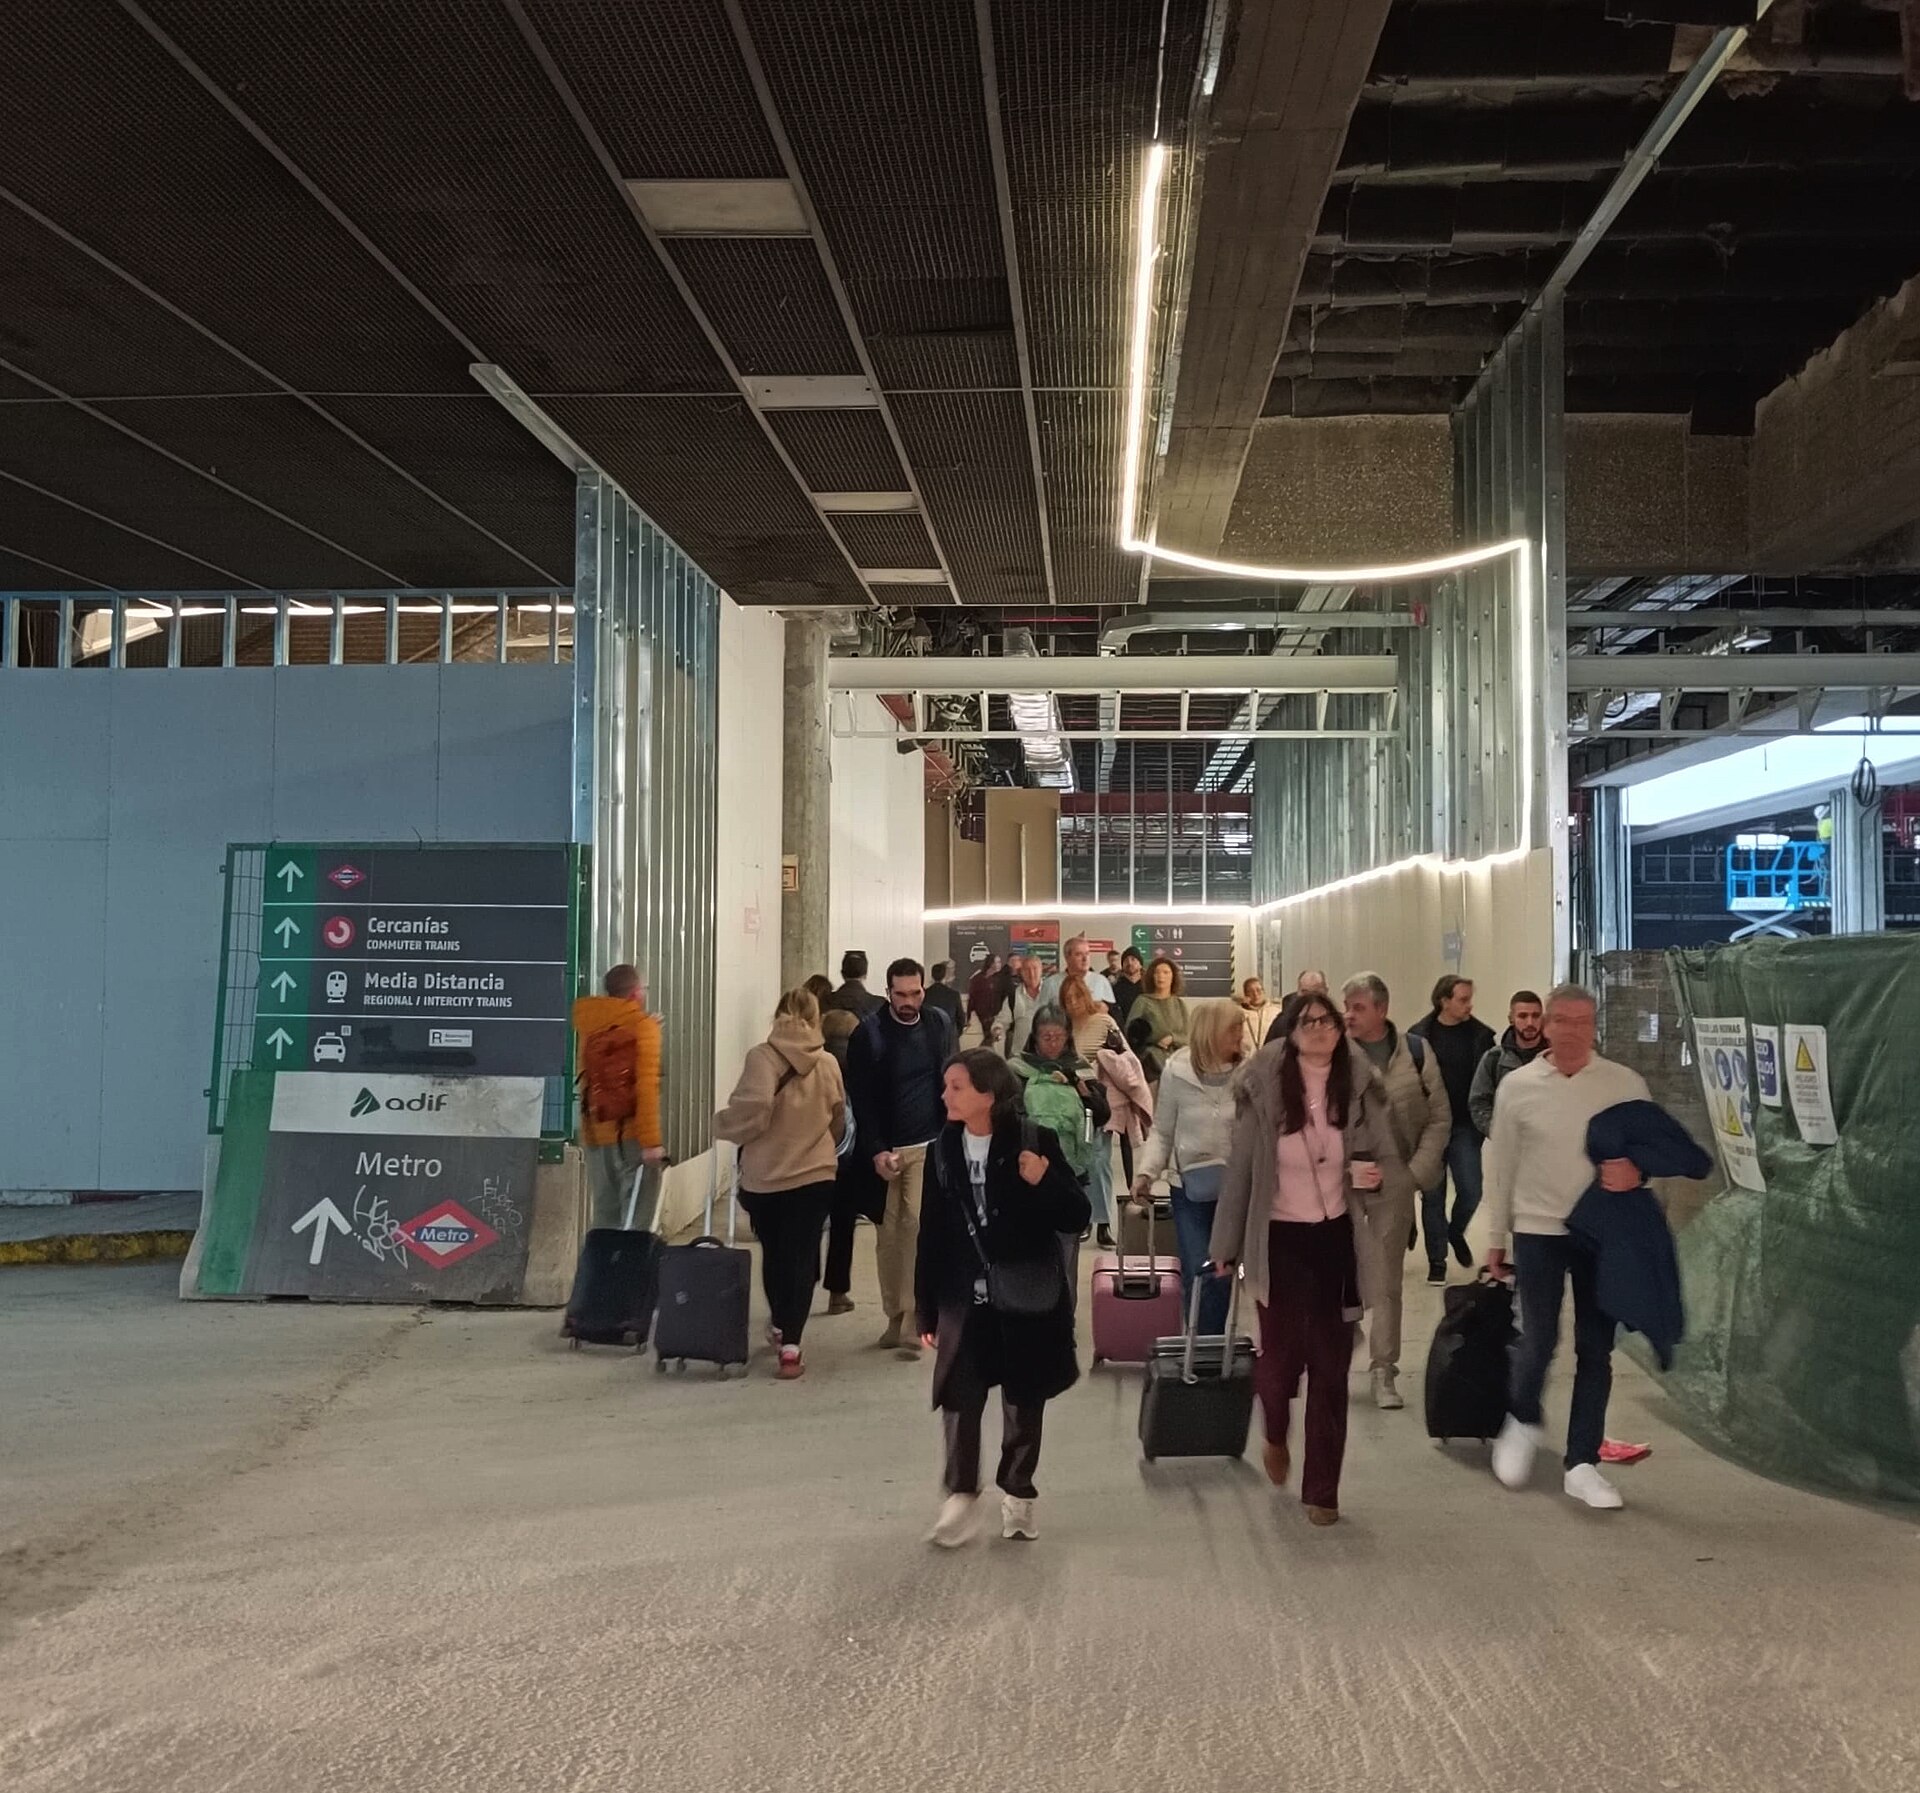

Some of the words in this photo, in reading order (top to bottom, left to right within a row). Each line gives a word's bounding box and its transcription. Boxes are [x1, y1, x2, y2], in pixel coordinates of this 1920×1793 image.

[367, 916, 450, 934] Cercanías
[366, 939, 422, 951] COMMUTER
[424, 940, 461, 951] TRAINS
[364, 972, 418, 989] Media
[424, 972, 505, 990] Distancia
[363, 995, 413, 1006] REGIONAL
[416, 995, 421, 1006] /
[423, 996, 474, 1007] INTERCITY
[477, 997, 513, 1008] TRAINS
[385, 1092, 449, 1111] adif
[355, 1151, 442, 1177] Metro
[419, 1228, 470, 1242] Metro
